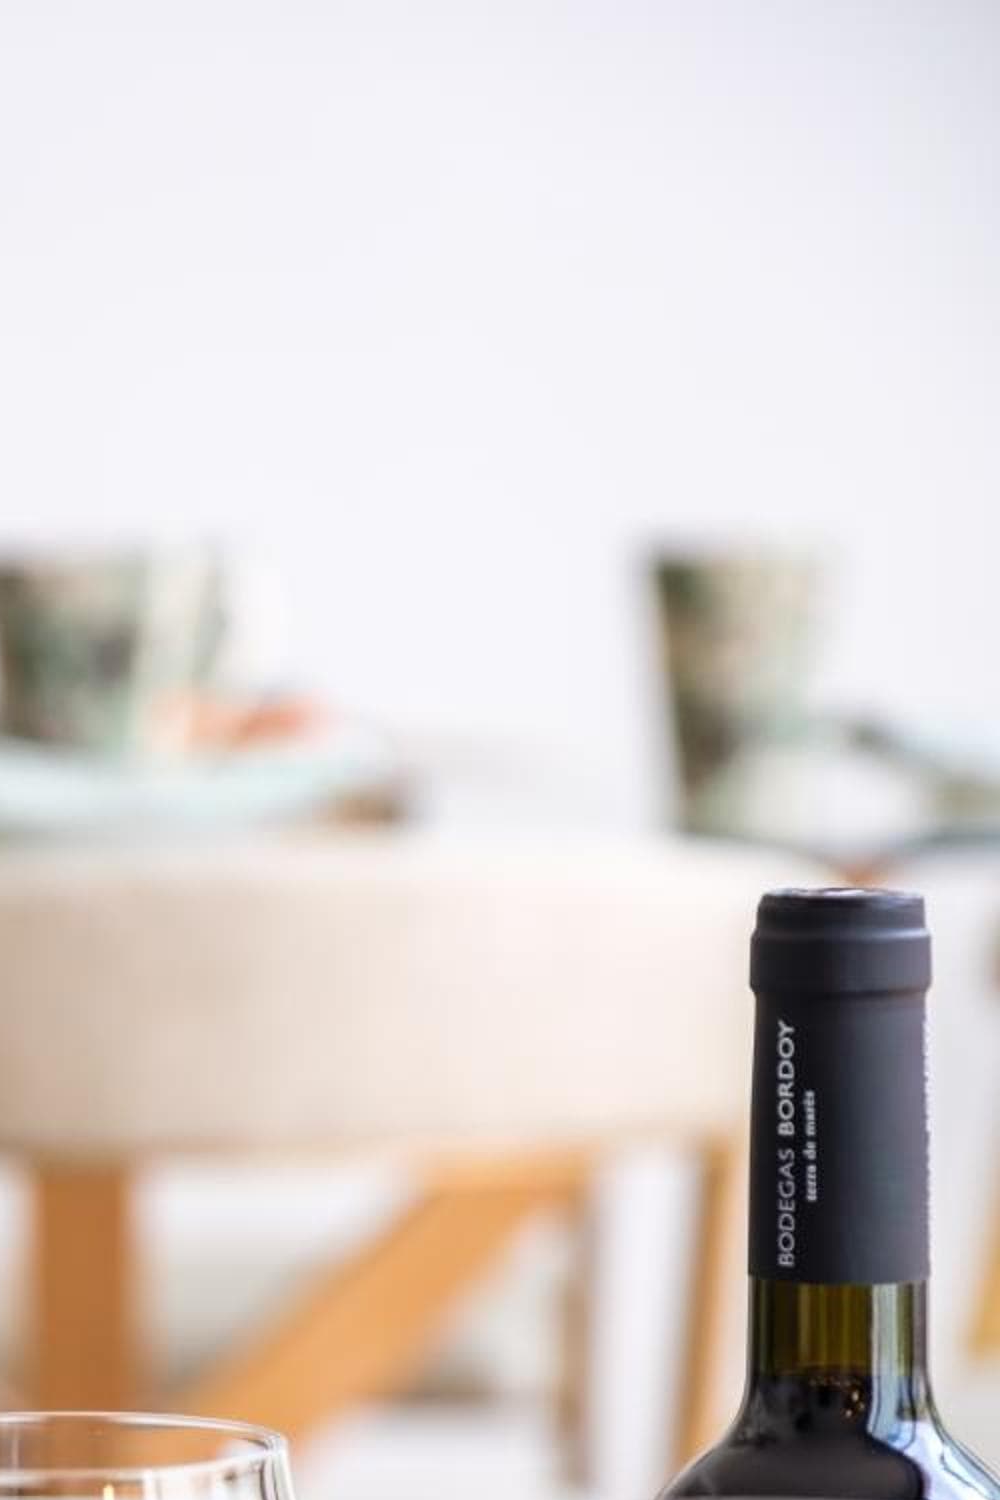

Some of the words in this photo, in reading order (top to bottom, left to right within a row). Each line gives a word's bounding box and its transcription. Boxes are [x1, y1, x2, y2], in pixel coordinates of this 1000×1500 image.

[777, 1019, 795, 1137] BORDOY
[802, 1141, 817, 1160] de
[804, 1164, 818, 1202] terra
[777, 1149, 795, 1267] BODEGAS
